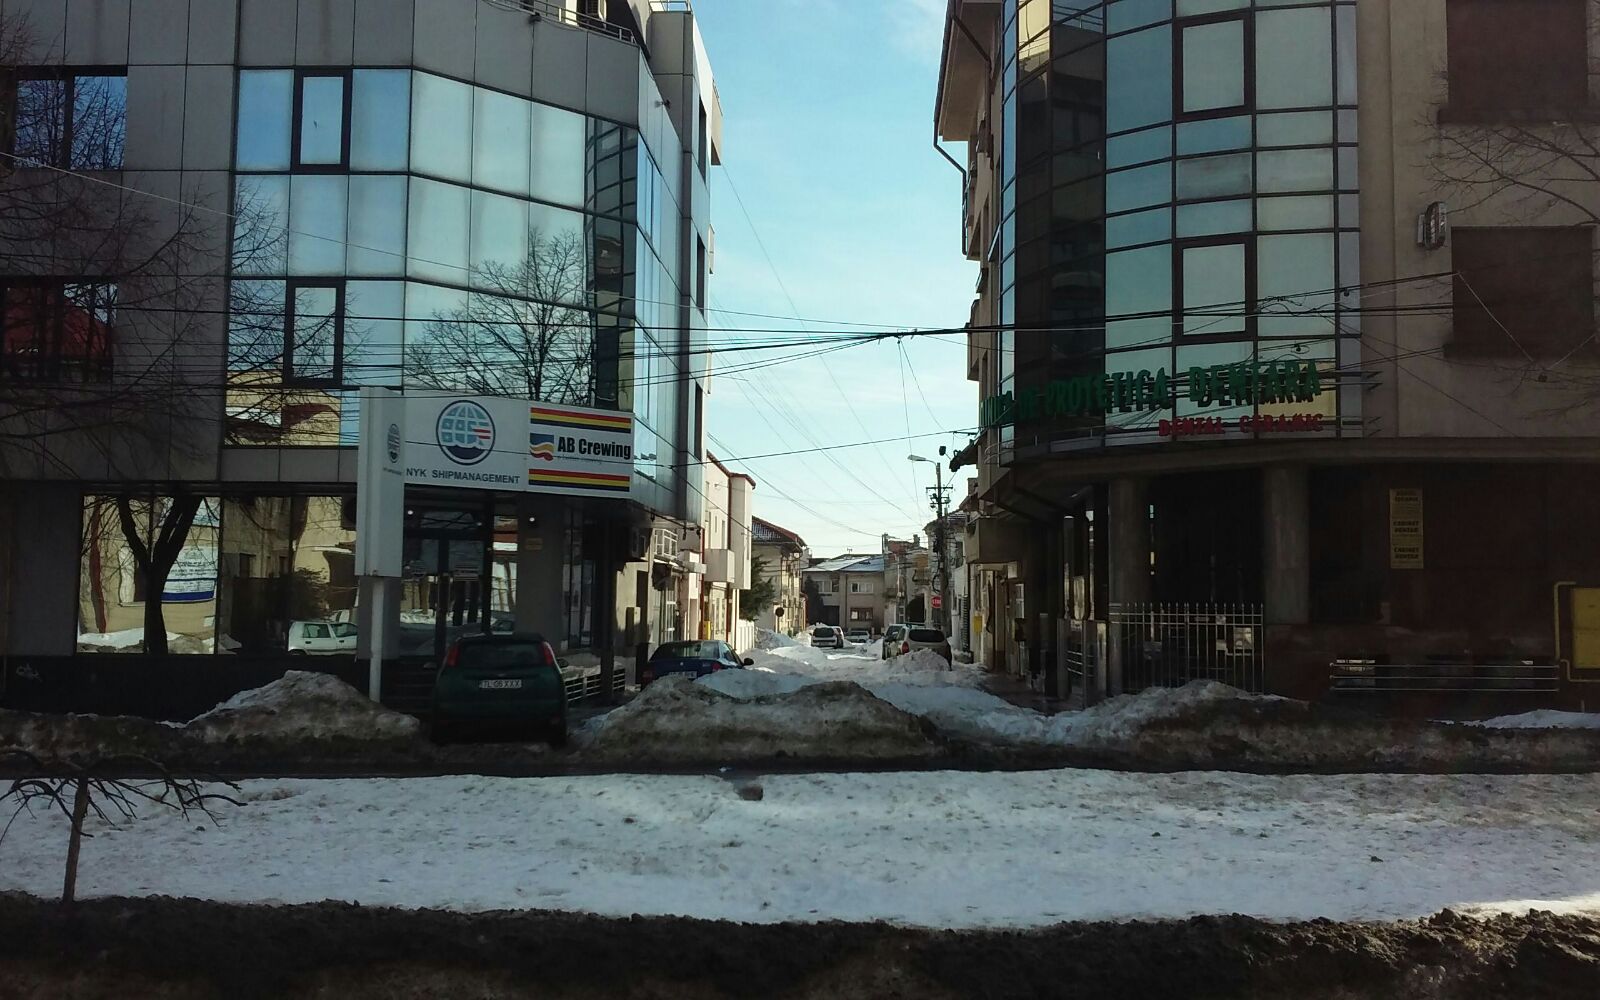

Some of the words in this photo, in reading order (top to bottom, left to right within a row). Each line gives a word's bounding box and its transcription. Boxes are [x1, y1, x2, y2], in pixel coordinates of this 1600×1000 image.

[1159, 416, 1226, 436] DENTAL
[1239, 413, 1324, 433] CERAMIC
[557, 436, 575, 453] AB
[578, 438, 631, 460] Crewing
[406, 467, 427, 479] NYK
[431, 469, 521, 485] SHIPMANAGEMENT
